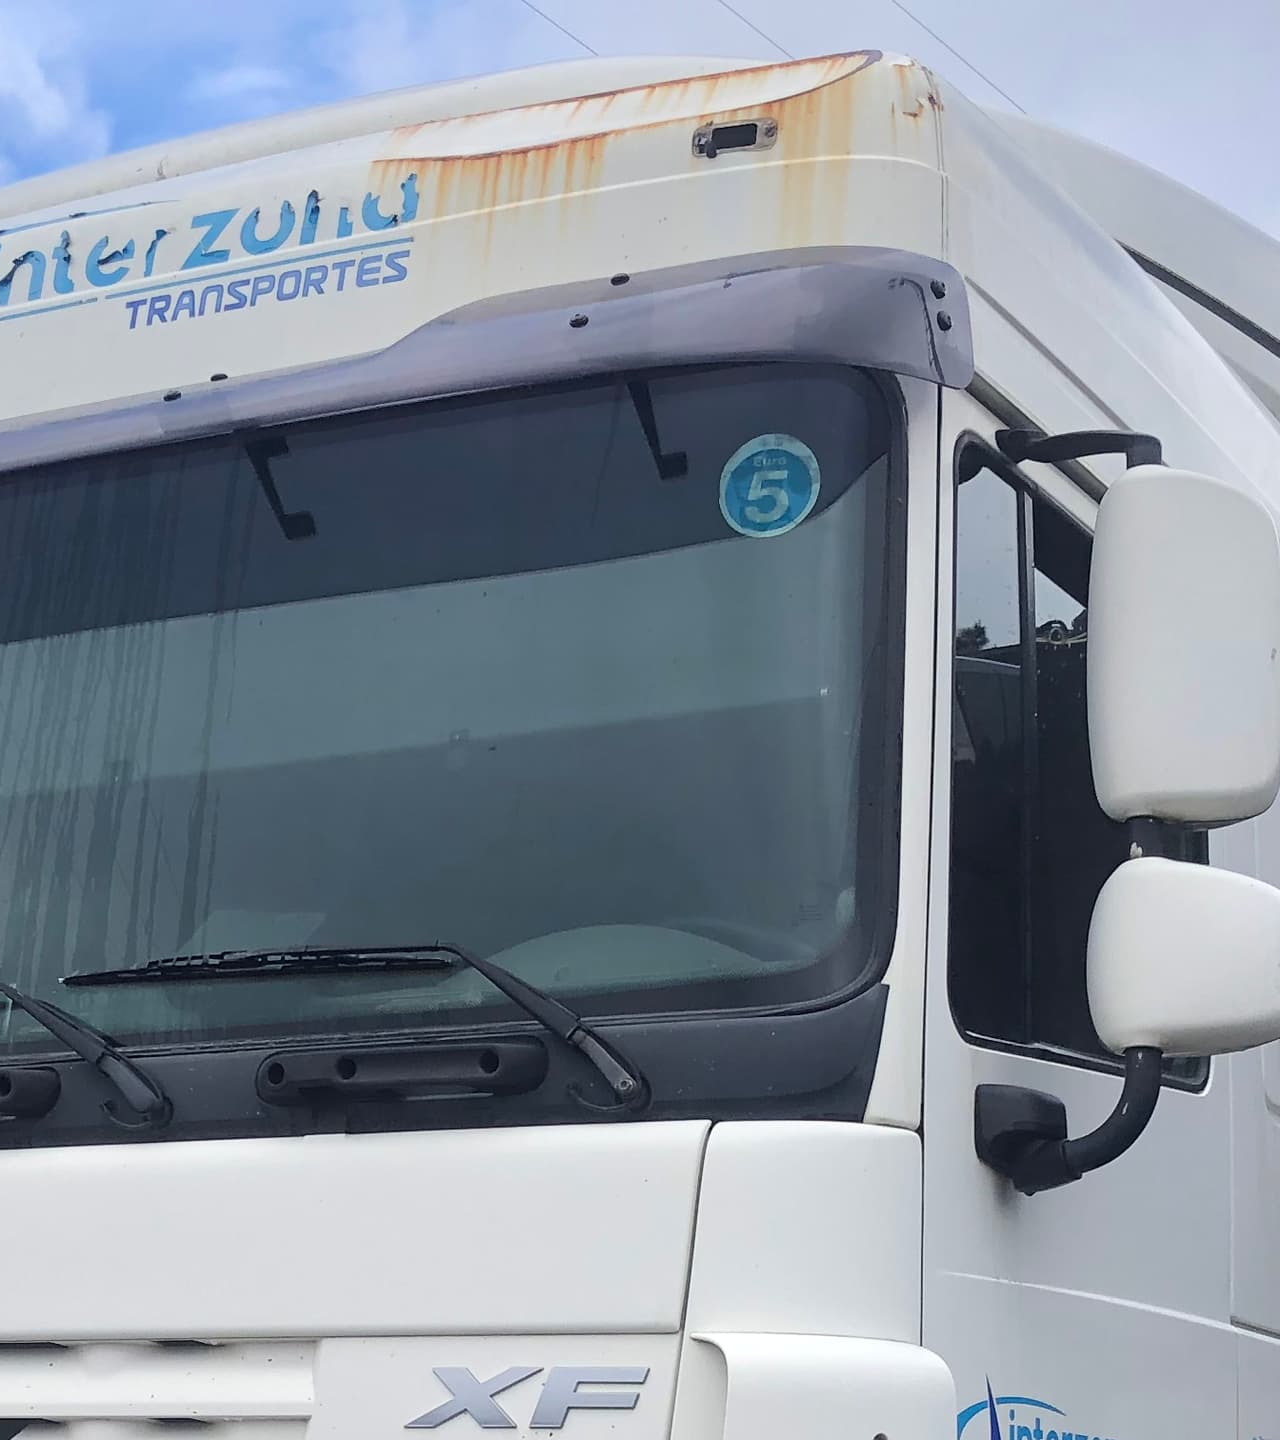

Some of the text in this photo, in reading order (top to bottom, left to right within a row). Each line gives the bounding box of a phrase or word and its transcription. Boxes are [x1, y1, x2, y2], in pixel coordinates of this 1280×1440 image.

[125, 249, 411, 330] TRANSPORTES
[744, 470, 789, 524] 5
[404, 1366, 650, 1429] XF
